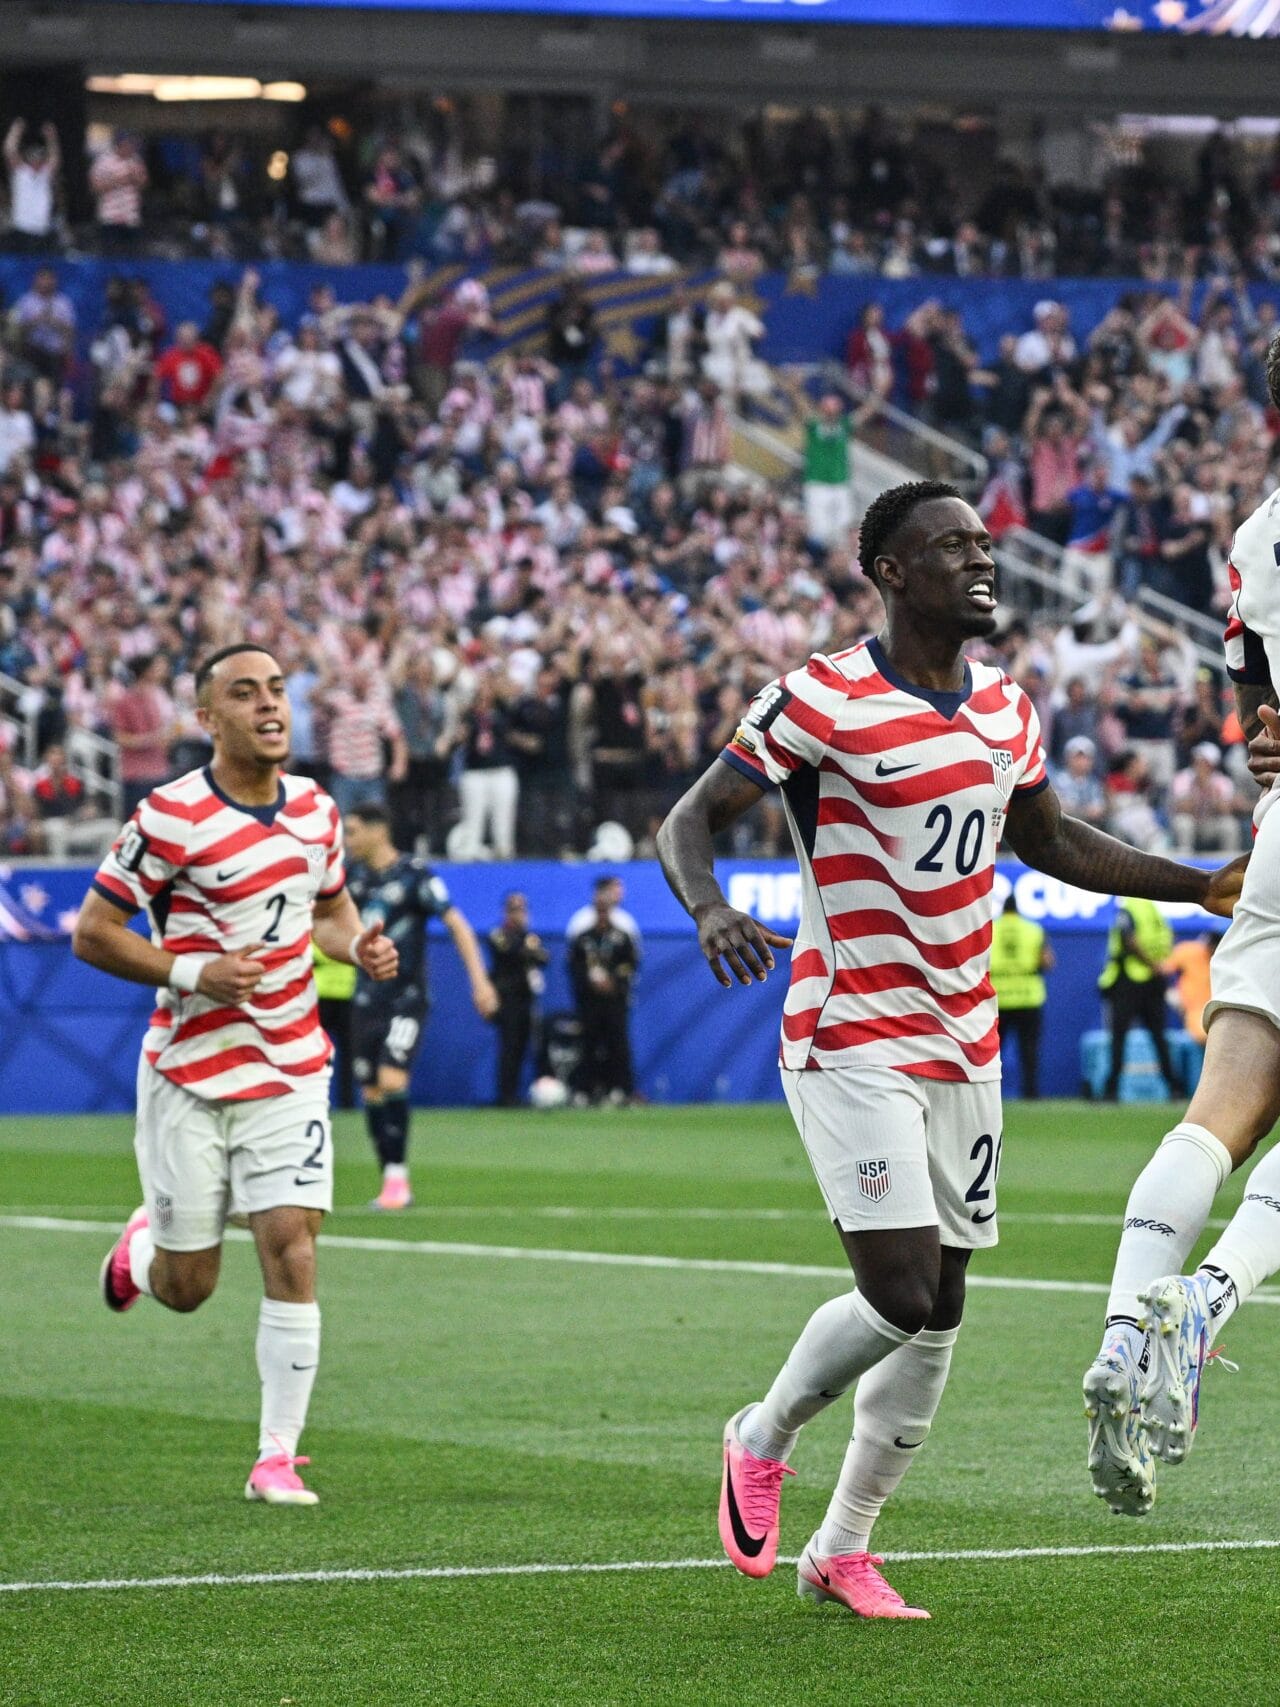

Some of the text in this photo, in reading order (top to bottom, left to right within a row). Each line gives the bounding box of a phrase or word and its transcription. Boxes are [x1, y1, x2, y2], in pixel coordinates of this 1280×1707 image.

[992, 751, 1012, 772] USA
[914, 804, 985, 876] 20
[261, 893, 286, 942] 2
[728, 873, 801, 921] FIF
[302, 1120, 325, 1169] 2
[859, 1160, 888, 1178] USA
[965, 1134, 1002, 1203] 2
